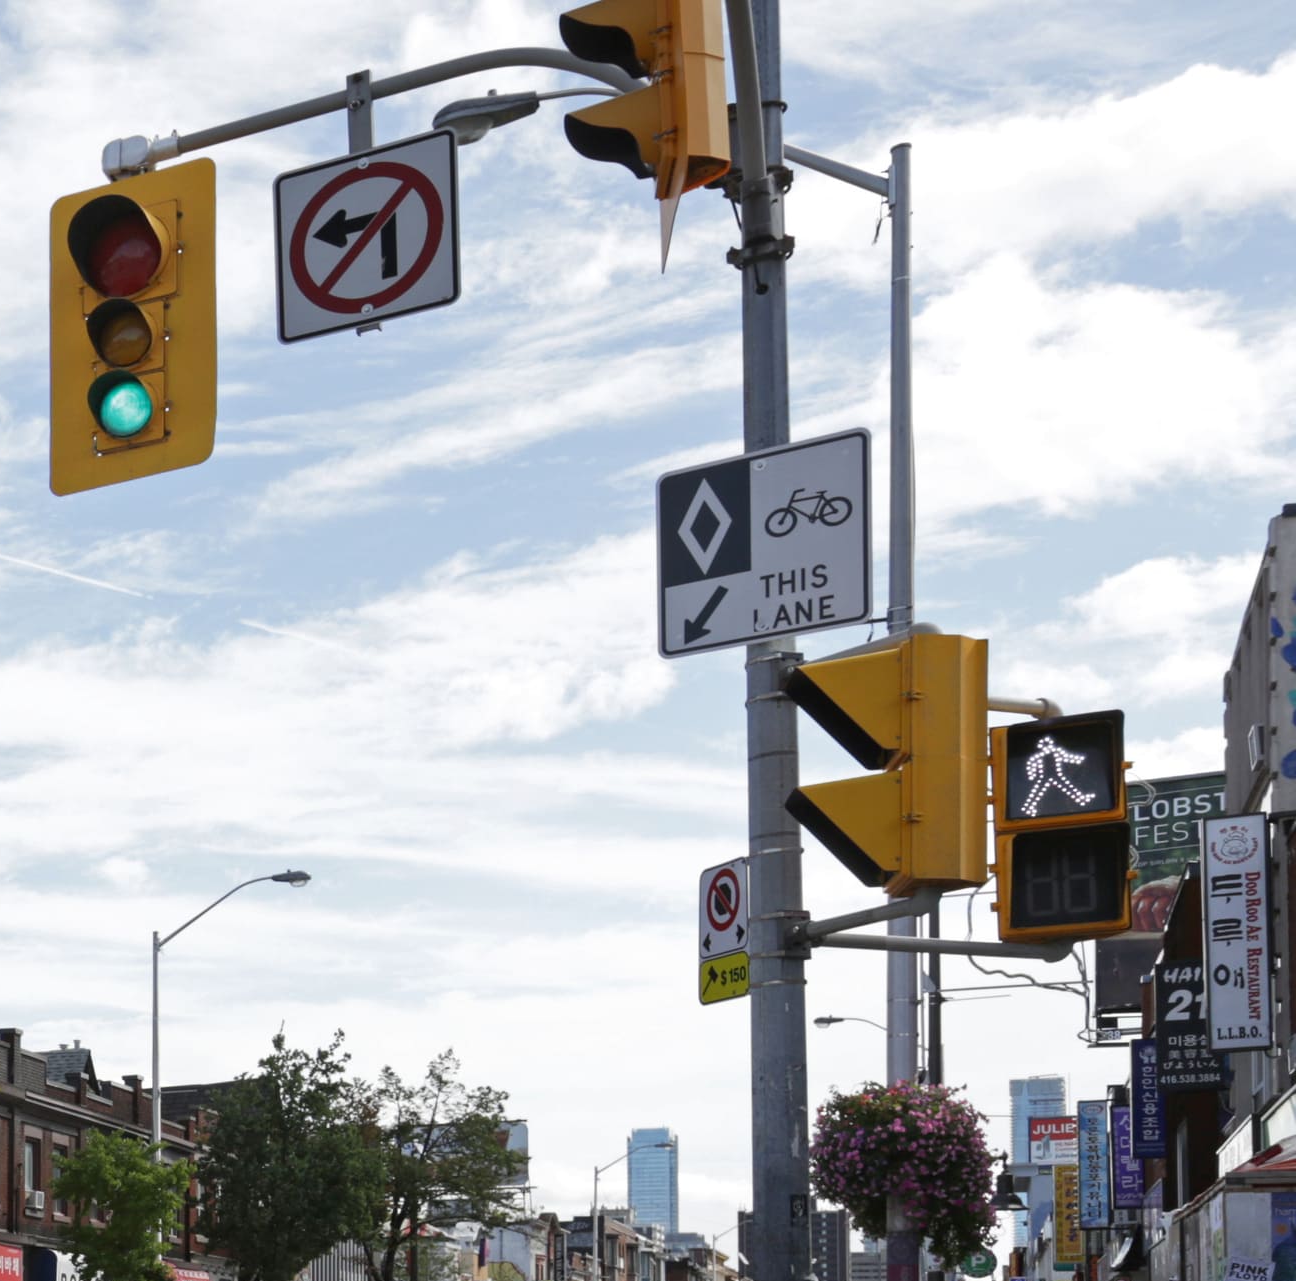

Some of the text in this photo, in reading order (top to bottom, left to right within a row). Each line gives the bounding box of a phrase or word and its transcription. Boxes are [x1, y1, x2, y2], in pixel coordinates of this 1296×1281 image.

[760, 564, 828, 598] THIS
[753, 595, 835, 632] LANE
[1135, 792, 1226, 822] LOBST
[1163, 966, 1203, 983] HAI
[1231, 1262, 1268, 1276] PINK
